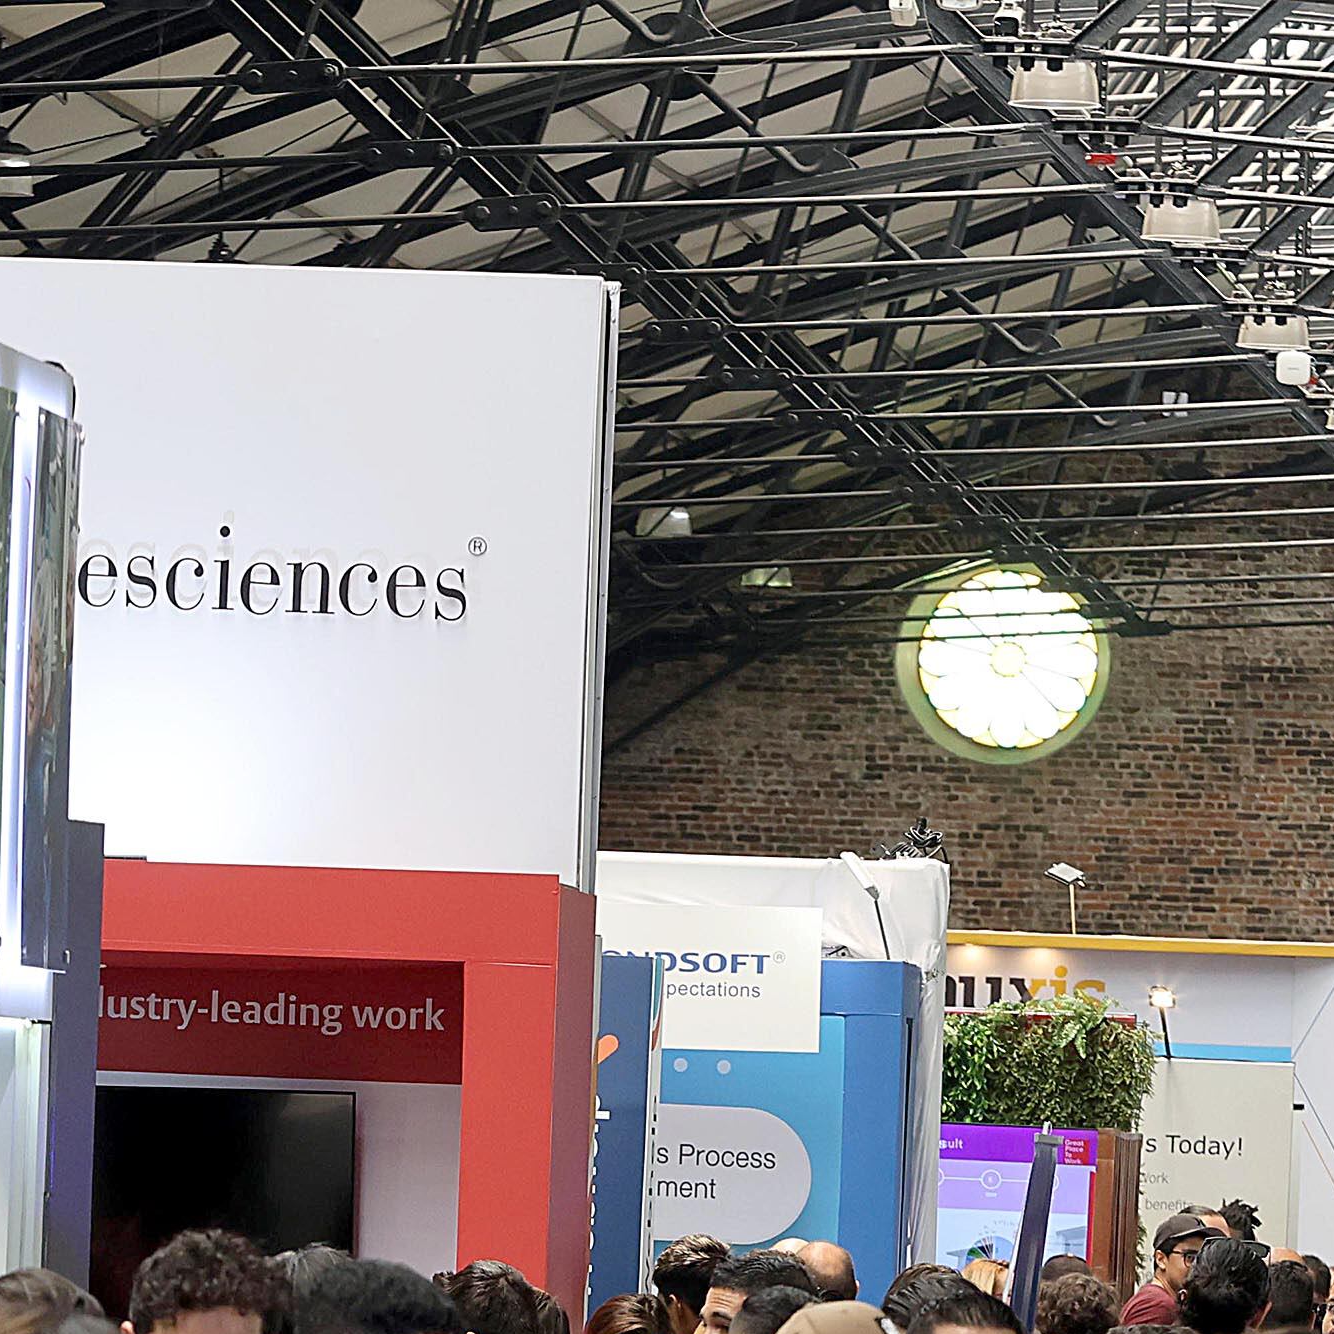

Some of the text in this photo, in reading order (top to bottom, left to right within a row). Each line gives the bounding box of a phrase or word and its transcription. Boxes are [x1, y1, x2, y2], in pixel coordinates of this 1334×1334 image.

[78, 525, 467, 621] esciences
[602, 950, 770, 974] DSOFT
[352, 998, 445, 1031] work
[679, 1143, 777, 1169] Process
[1165, 1134, 1243, 1161] Today!
[656, 1178, 717, 1199] ment
